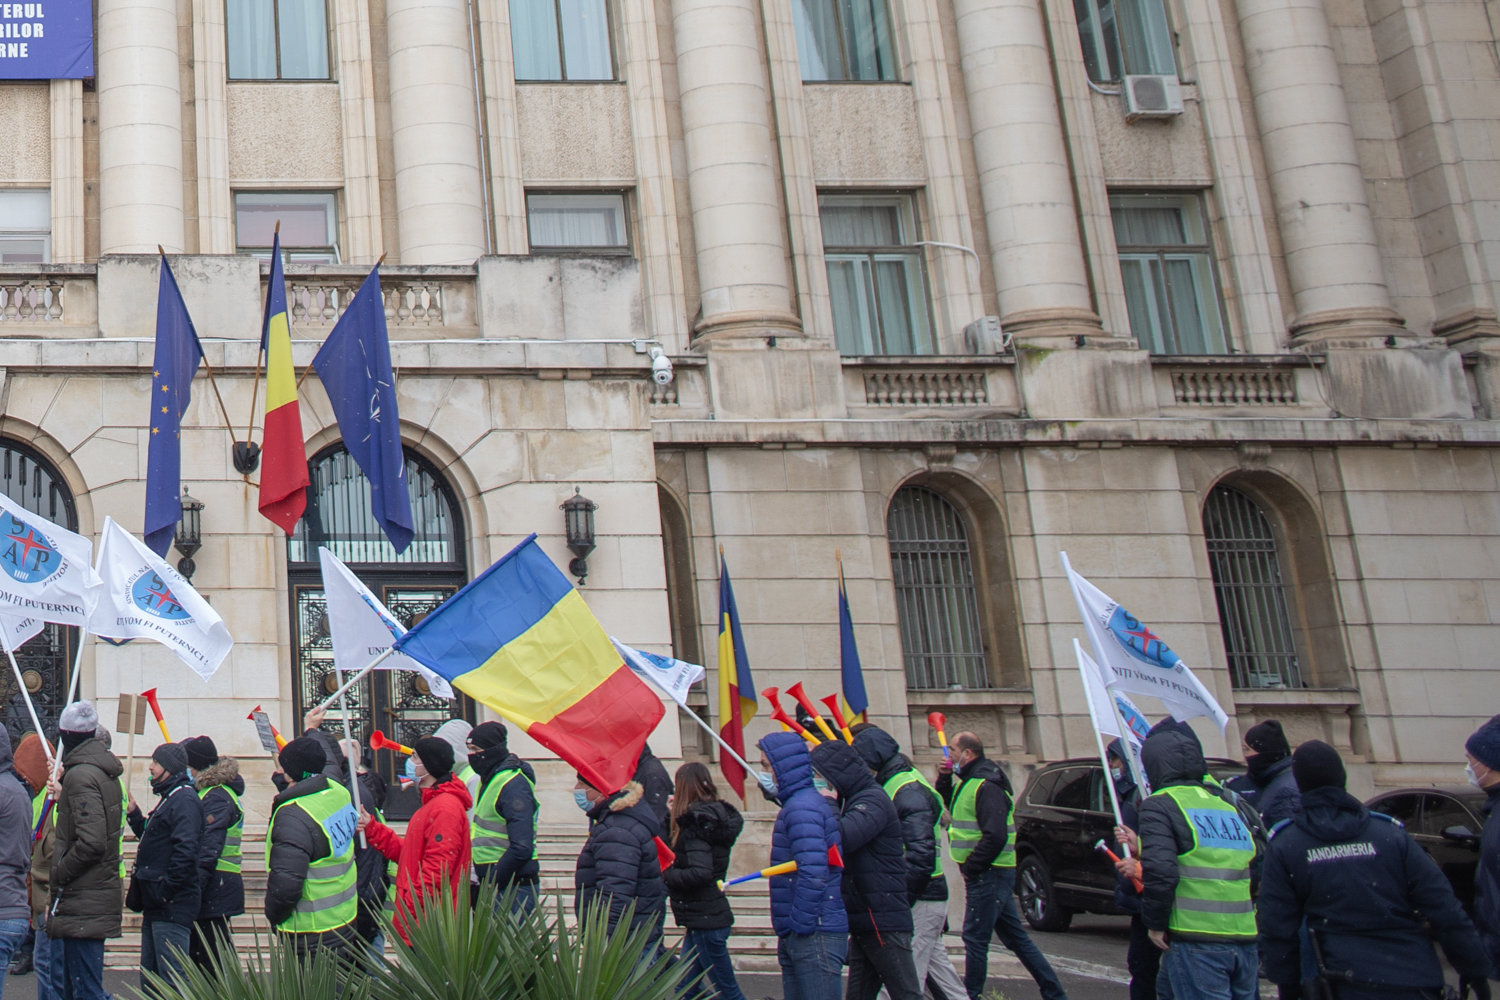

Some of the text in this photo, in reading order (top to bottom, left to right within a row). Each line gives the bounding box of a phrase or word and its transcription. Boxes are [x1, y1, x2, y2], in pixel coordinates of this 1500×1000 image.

[2, 541, 18, 566] A
[31, 549, 49, 572] P
[14, 595, 23, 606] FI
[136, 593, 183, 616] A P
[1123, 610, 1139, 630] S
[143, 620, 154, 628] FI
[155, 625, 205, 662] PUTERNICI
[1133, 670, 1157, 684] VOM
[1159, 677, 1170, 688] FI
[1193, 814, 1248, 842] S.N.A.P.
[1307, 843, 1377, 862] JANDARMERIA
